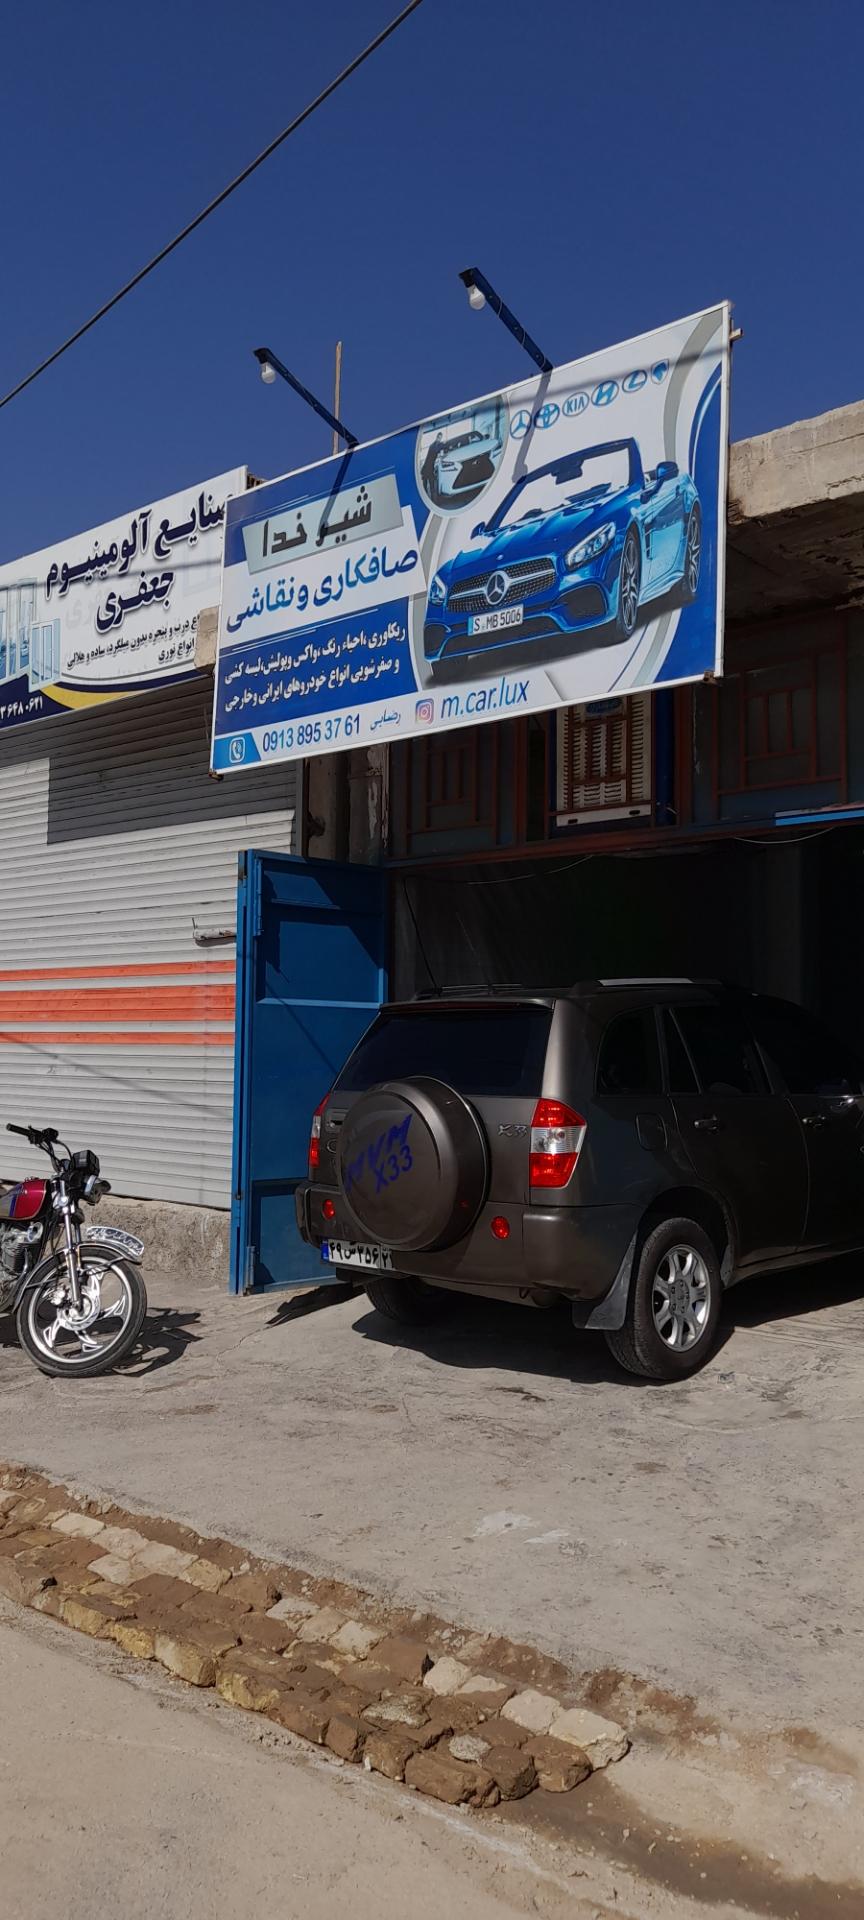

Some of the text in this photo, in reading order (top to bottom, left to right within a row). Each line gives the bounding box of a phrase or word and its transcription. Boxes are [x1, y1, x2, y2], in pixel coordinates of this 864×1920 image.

[262, 486, 372, 558] شیر خدا
[46, 509, 152, 598] آلومینیوم
[313, 546, 418, 607] صافکاری
[96, 571, 174, 631] جعفری
[500, 608, 521, 627] 5006
[368, 621, 406, 649] ریکاوری
[258, 680, 283, 705] ایرانی
[283, 670, 327, 699] خودروهای
[327, 664, 350, 689] انواع
[440, 676, 530, 719] m.car.lux
[262, 712, 360, 752] 0913 895 37 61
[374, 1144, 413, 1194] X33
